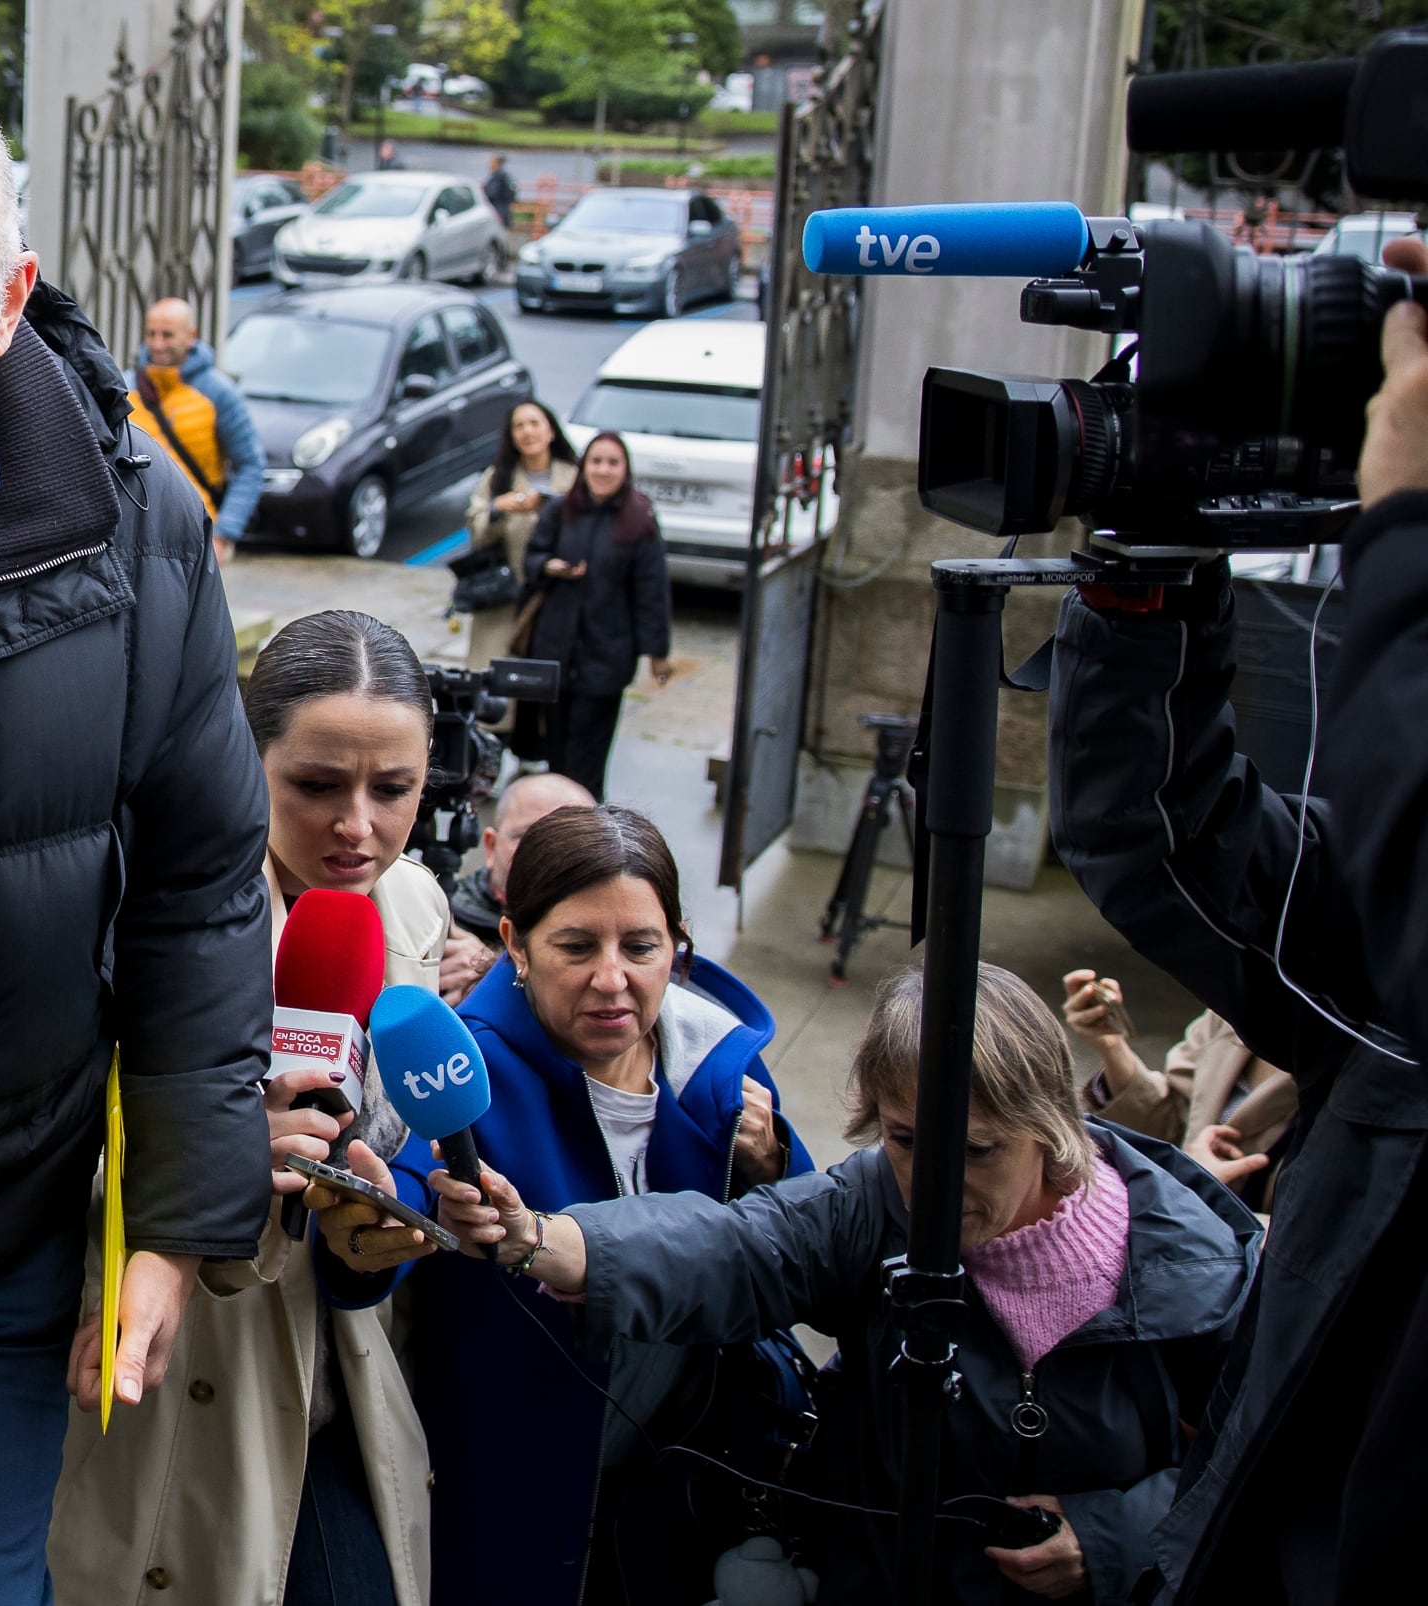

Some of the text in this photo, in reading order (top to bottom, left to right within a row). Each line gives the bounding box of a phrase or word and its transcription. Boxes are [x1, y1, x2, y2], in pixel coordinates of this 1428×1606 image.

[855, 225, 941, 273] tve
[1042, 572, 1095, 583] MONOPOD
[276, 1032, 322, 1044] EN BOCA
[282, 1042, 337, 1056] DE TODOS
[402, 1052, 474, 1099] tve
